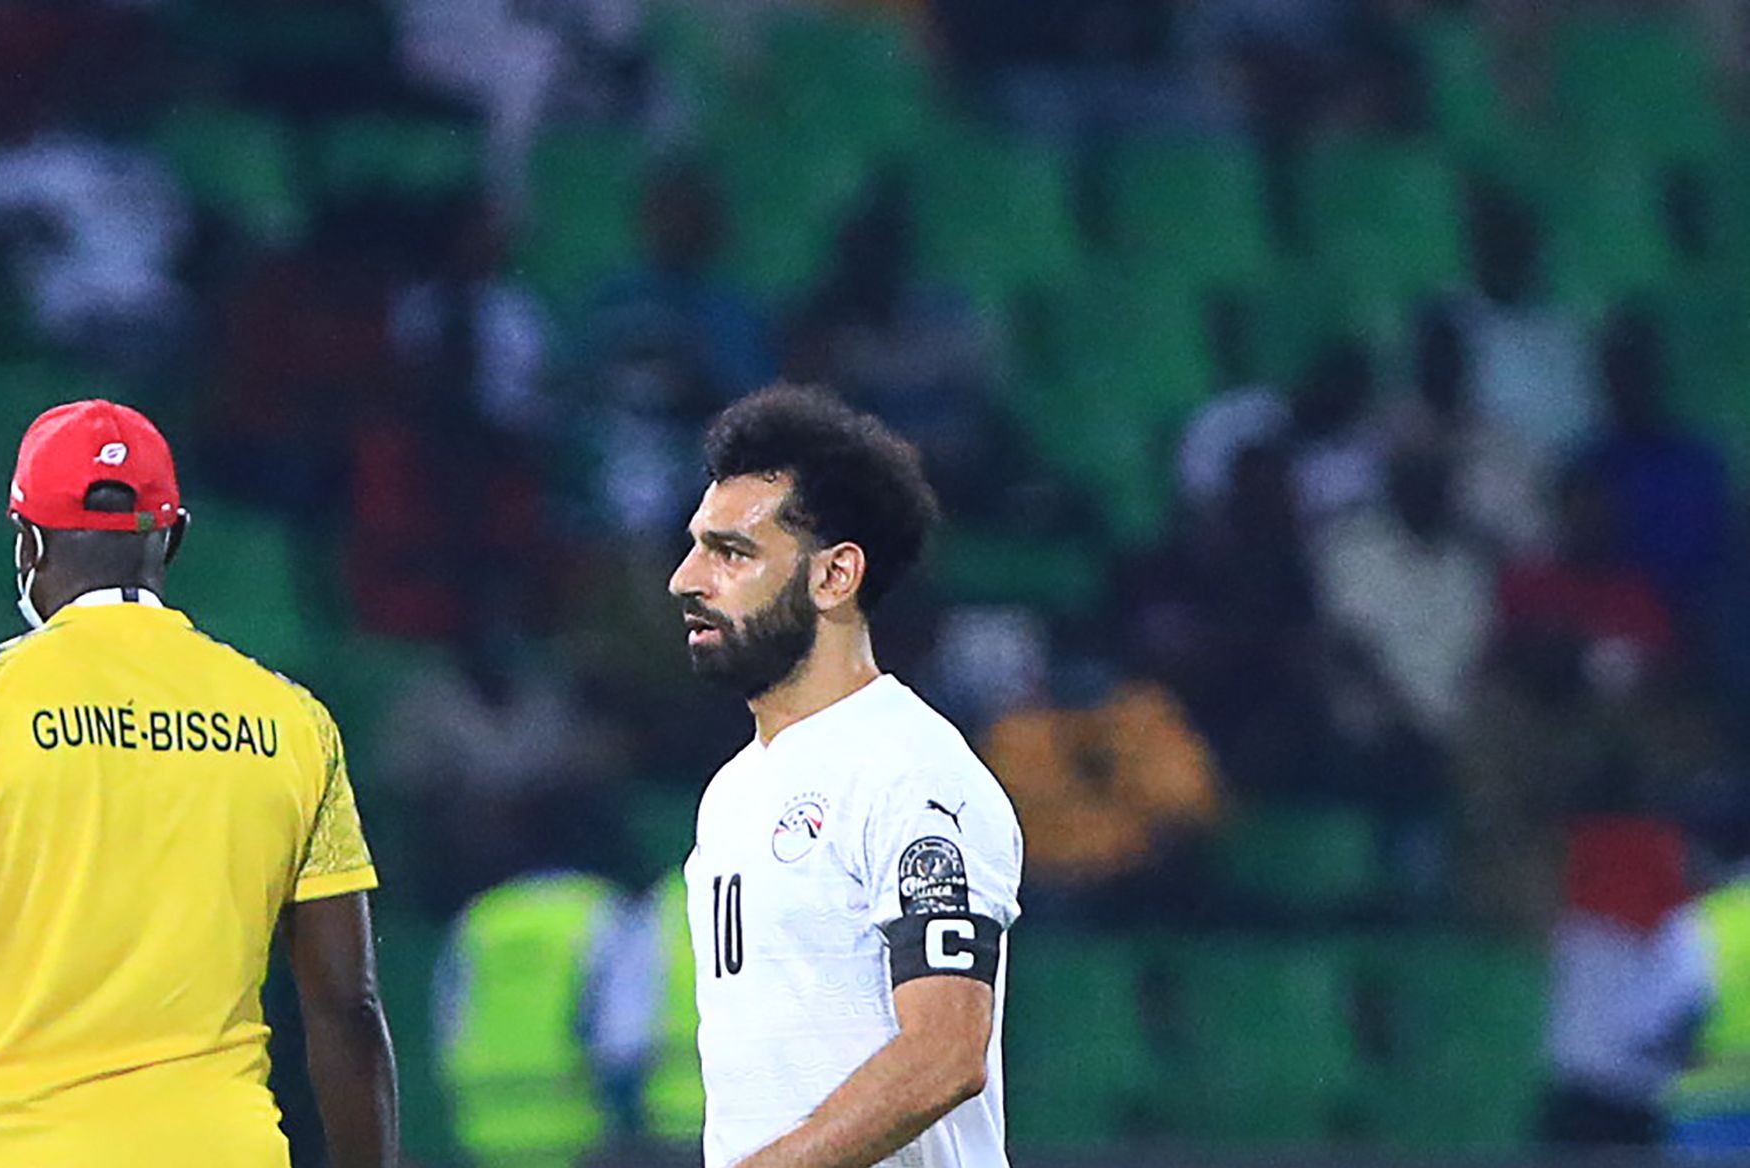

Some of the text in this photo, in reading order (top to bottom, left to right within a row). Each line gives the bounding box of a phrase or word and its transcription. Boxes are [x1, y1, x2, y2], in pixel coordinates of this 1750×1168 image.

[33, 699, 278, 758] GUINÉ-BISSAU
[712, 873, 744, 978] 10
[925, 918, 975, 970] C
